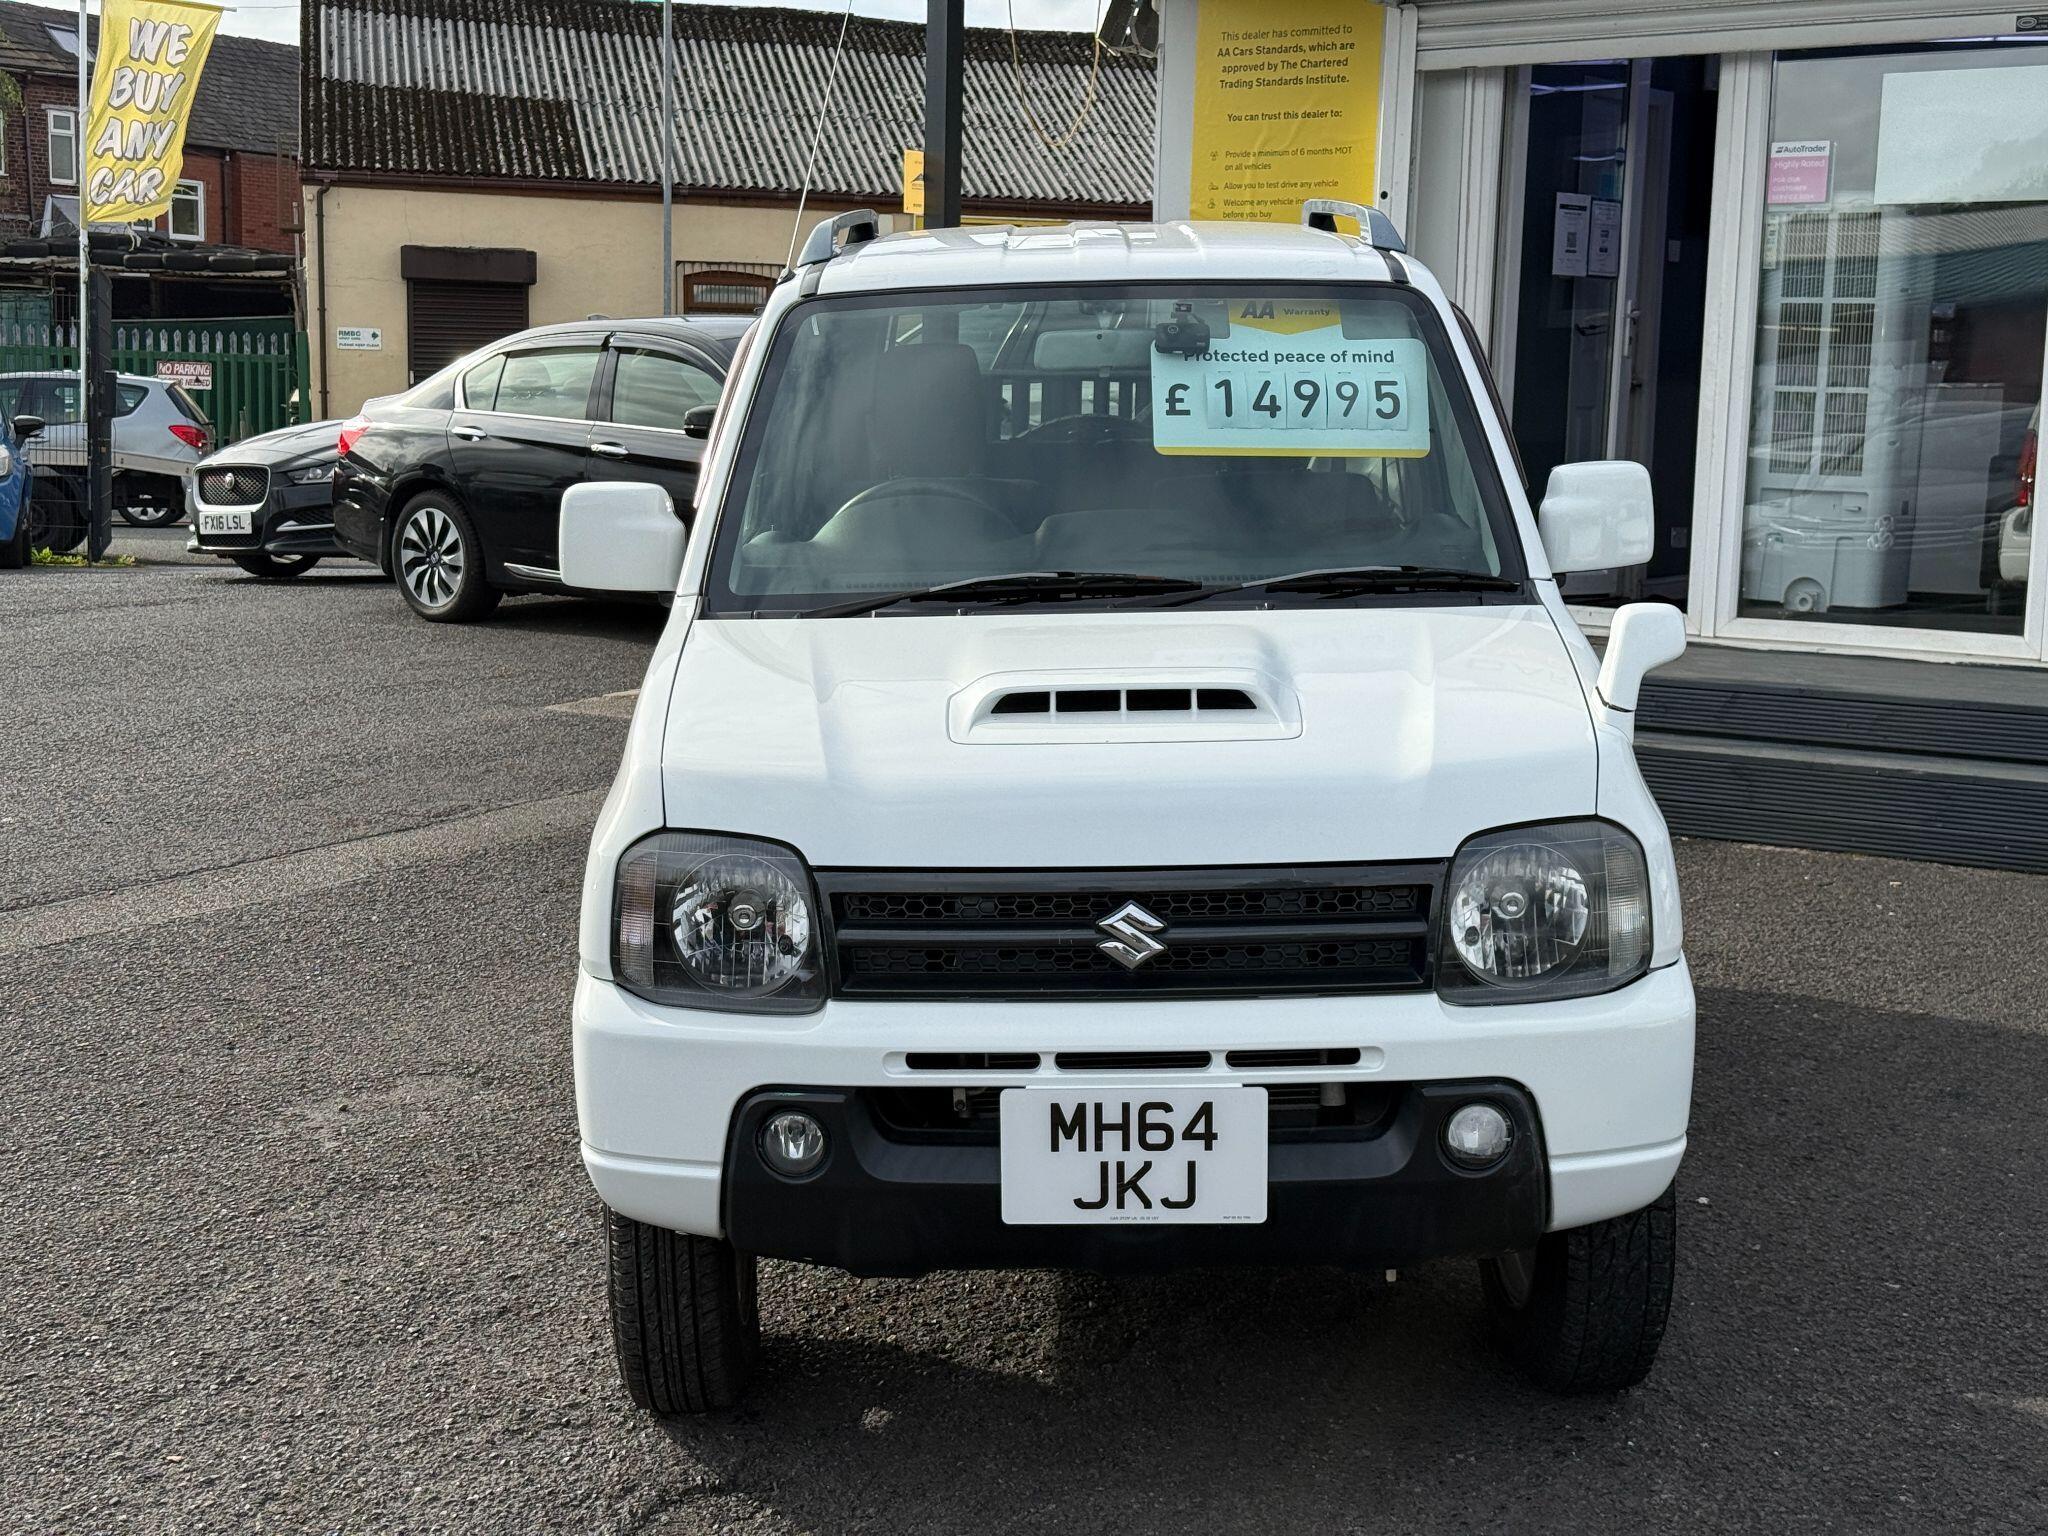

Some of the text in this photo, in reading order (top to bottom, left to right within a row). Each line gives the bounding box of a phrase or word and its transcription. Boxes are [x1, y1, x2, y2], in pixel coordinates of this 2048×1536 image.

[1221, 24, 1353, 41] This dealer has committed to
[129, 17, 195, 67] WE
[1217, 41, 1355, 57] AA Cars Standards, which are
[1222, 57, 1348, 74] approved by The Chartered
[108, 66, 186, 112] BUY
[1220, 74, 1350, 89] Trading Standards Institute.
[1227, 109, 1342, 122] You can trust this dealer to:
[93, 117, 177, 161] ANY
[1225, 150, 1250, 158] Provide
[1257, 149, 1289, 157] minimum
[1291, 148, 1299, 156] of
[1300, 147, 1305, 156] 6
[1306, 147, 1333, 155] months
[1335, 146, 1352, 154] MOT
[1783, 145, 1826, 153] AutoTrader
[1244, 162, 1272, 170] vehicles
[1774, 159, 1825, 170] Highly Rated
[89, 167, 165, 205] CAR
[1223, 179, 1339, 190] Allow you to test drive any vehicle
[1223, 198, 1255, 207] Welcome
[1256, 199, 1268, 207] any
[1269, 197, 1294, 205] vehicle
[1222, 210, 1273, 219] before you buy
[1240, 300, 1331, 320] AA Warranty
[1183, 350, 1395, 364] Protected peace of mind
[159, 362, 210, 375] NO PARKING
[204, 515, 246, 530] FX16 LSL
[1050, 1101, 1219, 1152] MH64
[1073, 1160, 1197, 1210] JKJ
